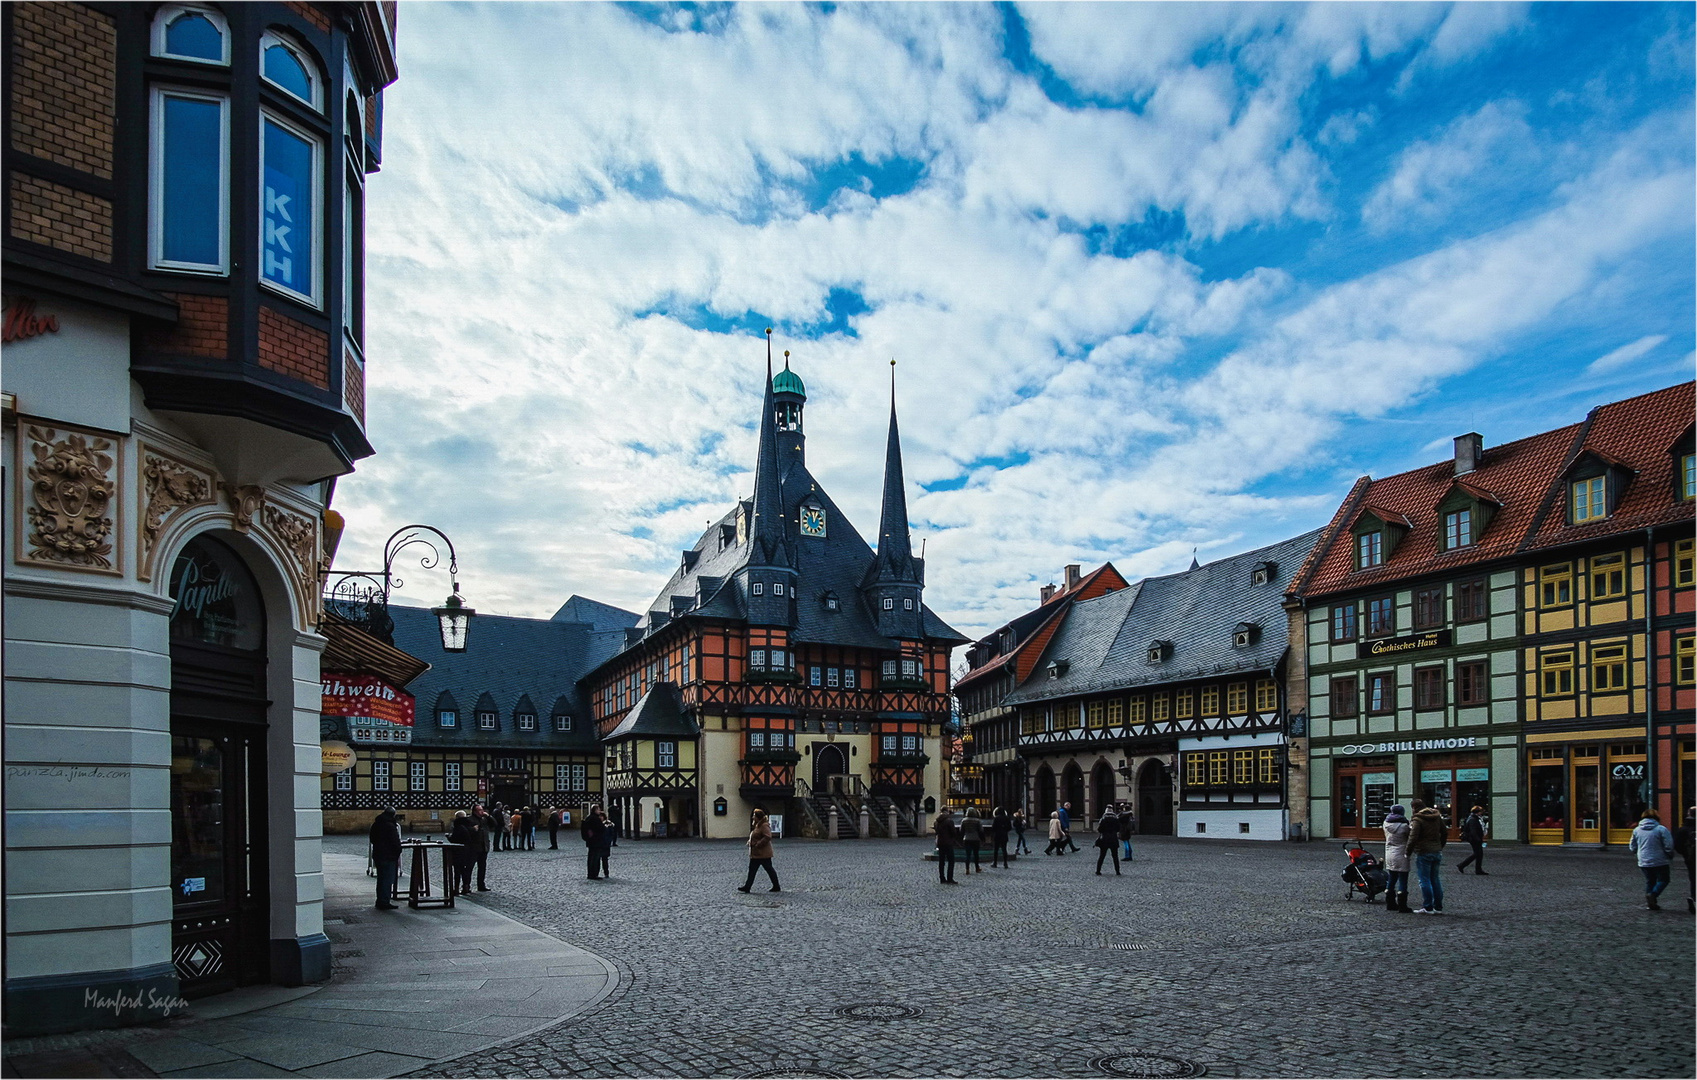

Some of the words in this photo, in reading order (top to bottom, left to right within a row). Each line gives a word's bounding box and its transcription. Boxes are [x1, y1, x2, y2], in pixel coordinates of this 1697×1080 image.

[264, 185, 293, 284] KKH
[1417, 639, 1438, 648] Haus
[320, 680, 395, 701] ühwein
[1379, 737, 1475, 752] BRILLENMODE
[322, 750, 351, 759] fé-Lounge
